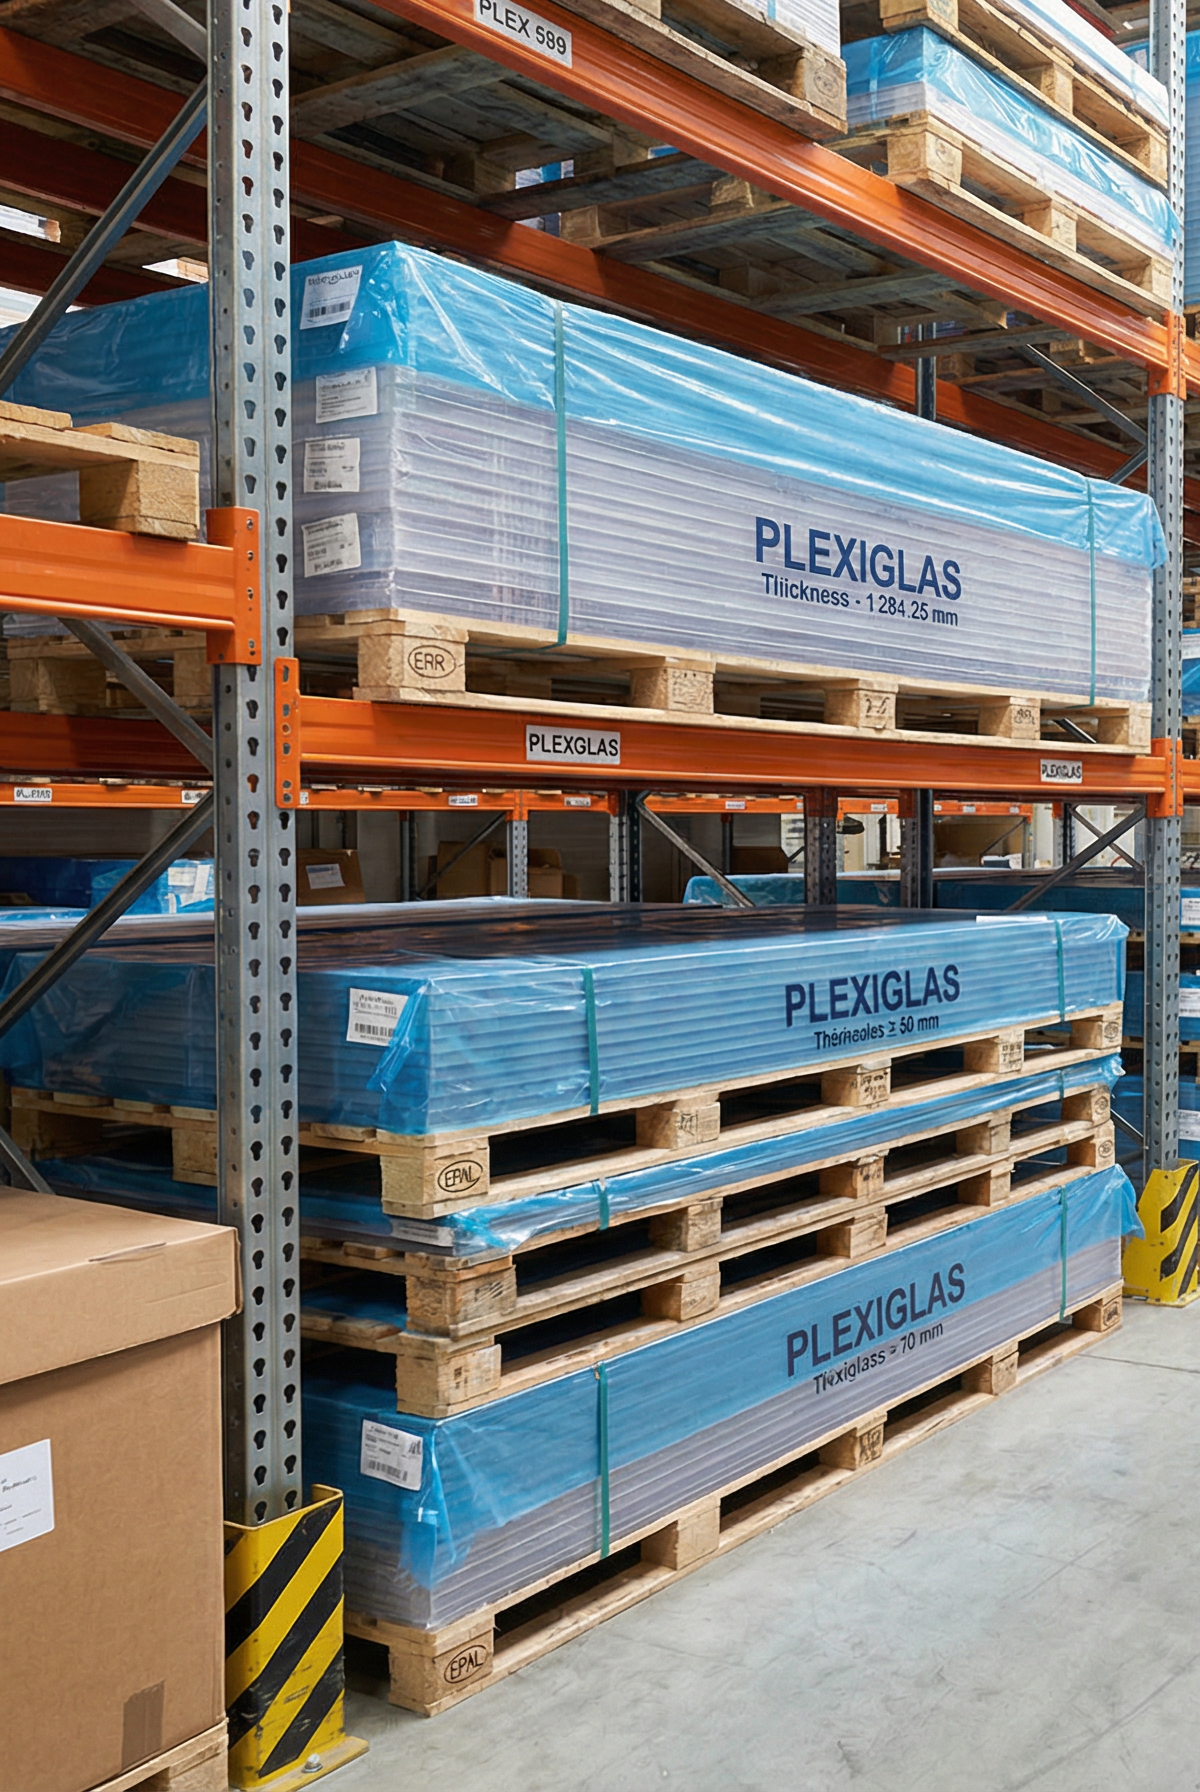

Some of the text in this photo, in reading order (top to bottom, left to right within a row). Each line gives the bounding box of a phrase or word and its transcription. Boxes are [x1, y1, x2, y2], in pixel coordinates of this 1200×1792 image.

[480, 0, 531, 39] PLEX
[755, 516, 962, 601] PLEXIGLAS
[932, 608, 959, 627] mm
[528, 733, 619, 757] PLEXGLAS
[785, 964, 961, 1028] PLEXIGLAS
[917, 1015, 939, 1031] mm
[786, 1262, 966, 1378] PLEXIGLAS
[900, 1332, 916, 1353] 70
[920, 1323, 943, 1345] mm
[450, 1649, 484, 1680] EPAL
